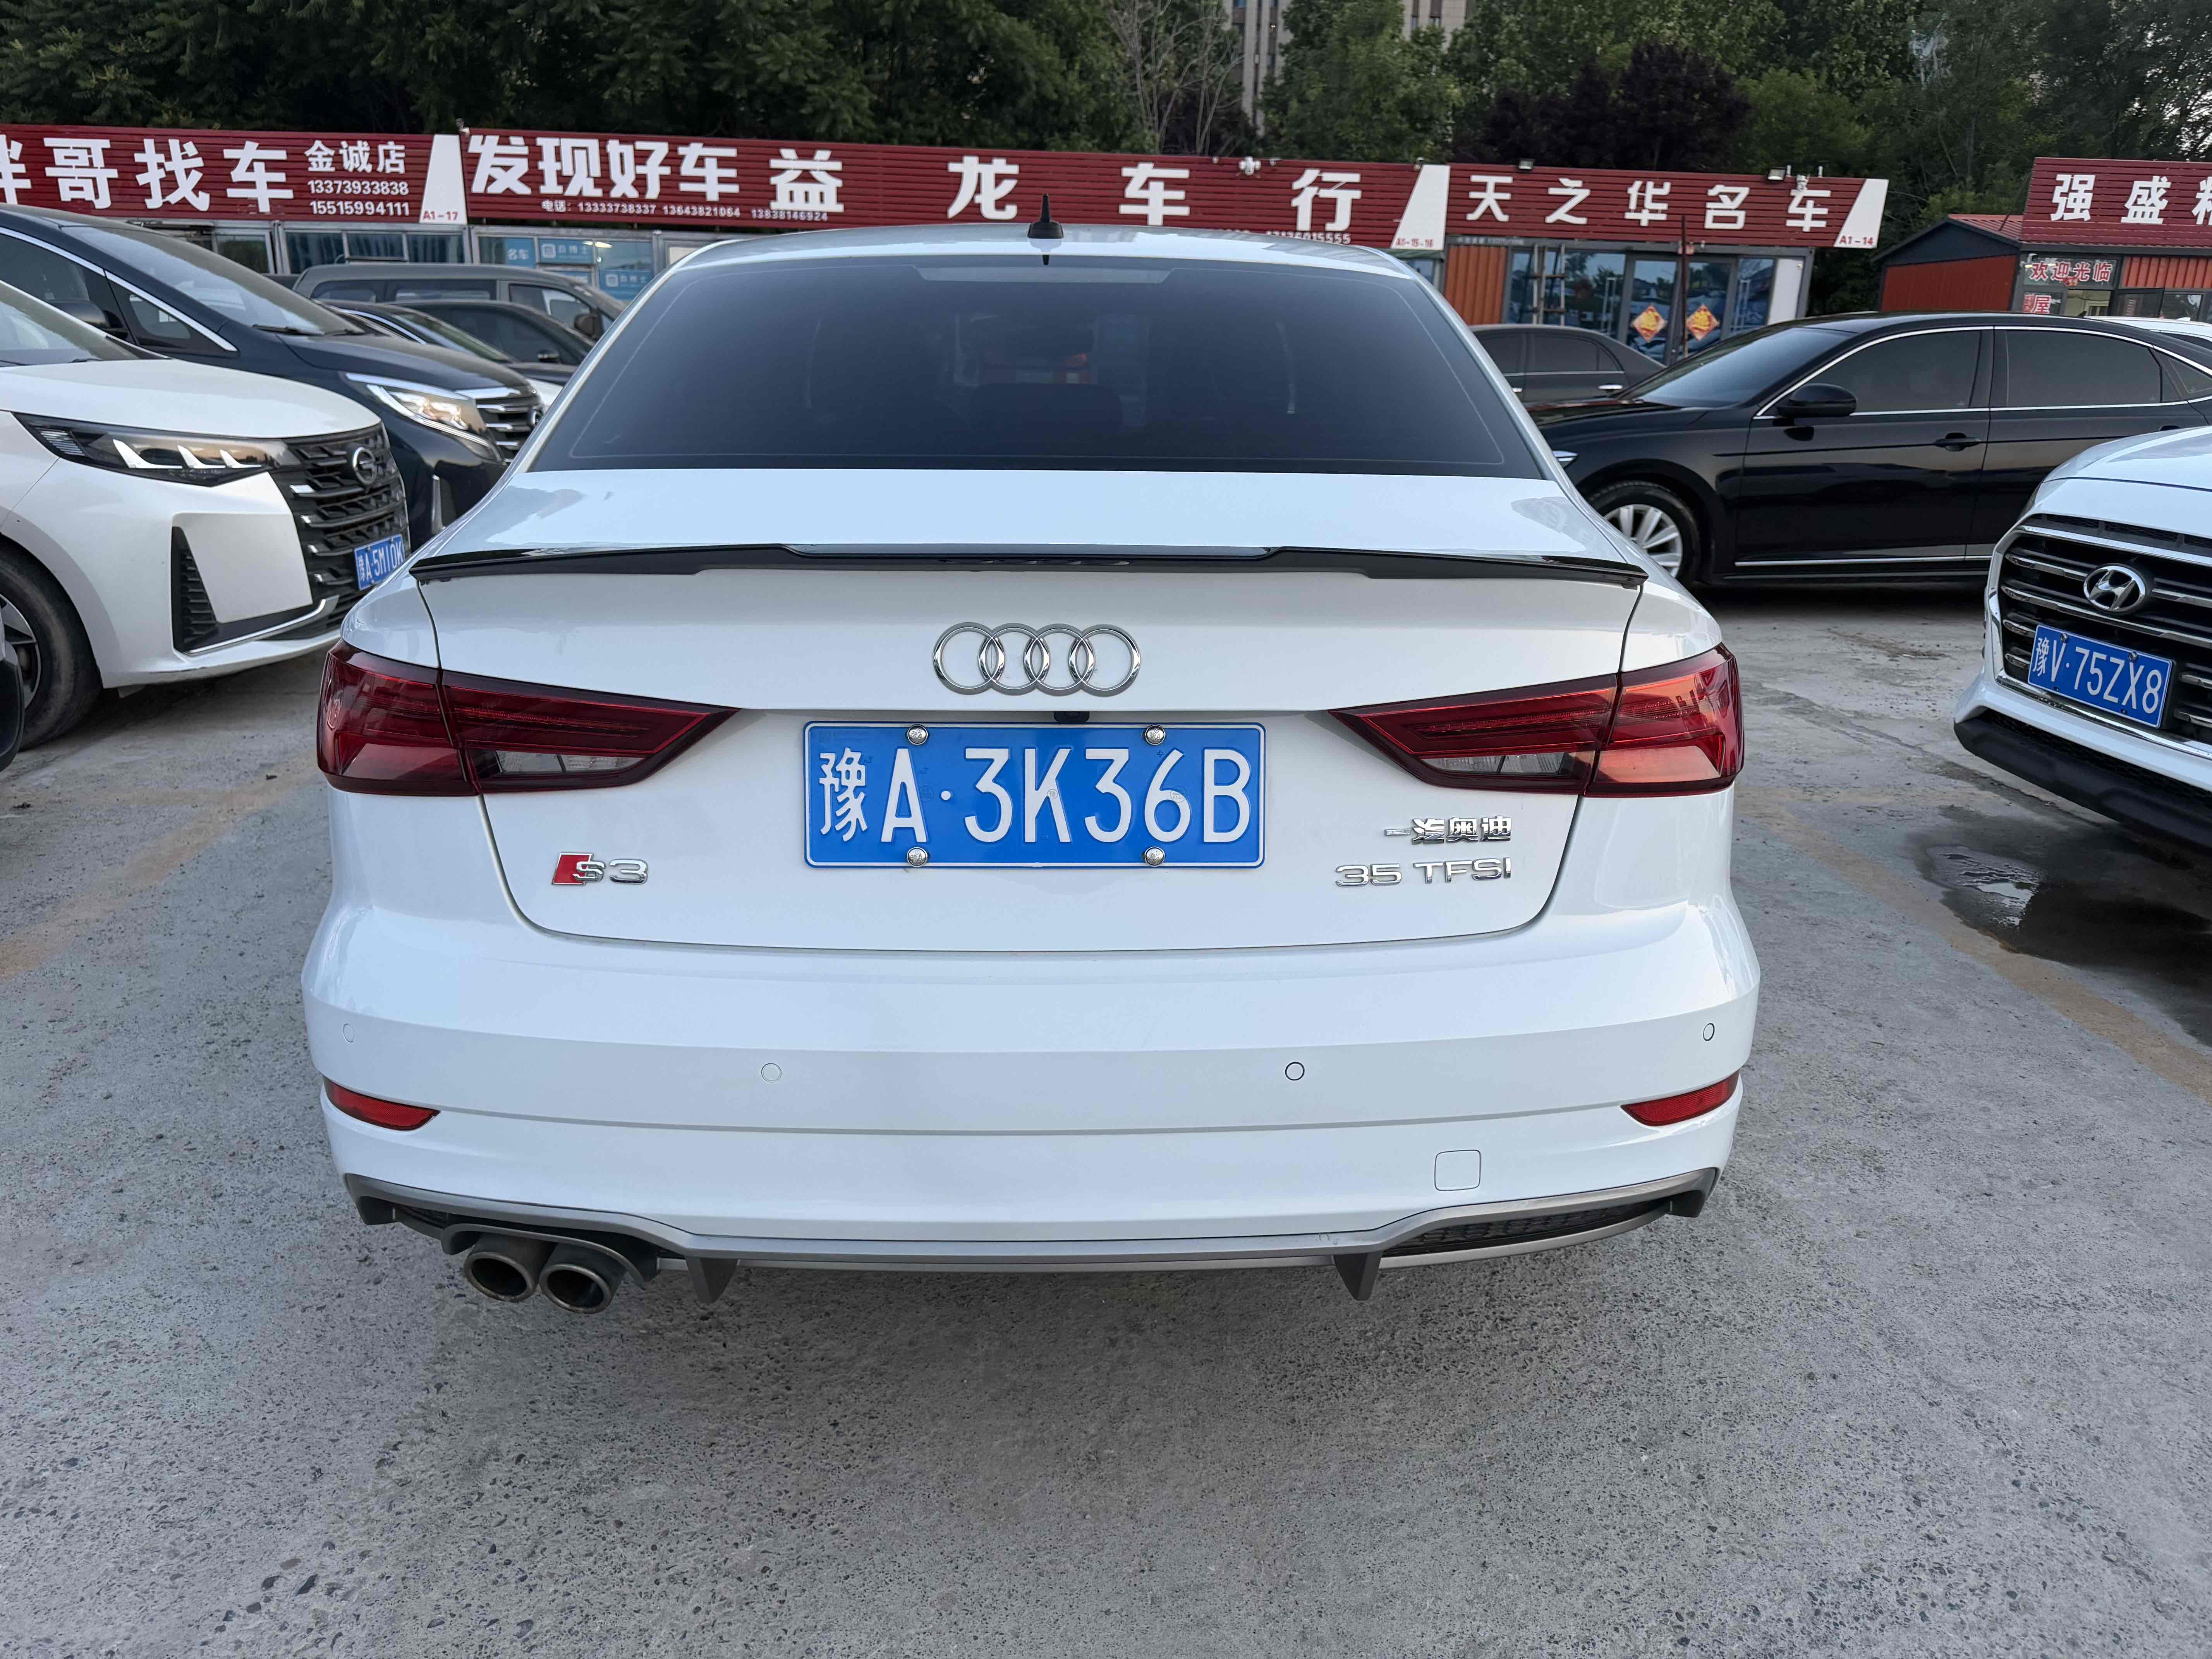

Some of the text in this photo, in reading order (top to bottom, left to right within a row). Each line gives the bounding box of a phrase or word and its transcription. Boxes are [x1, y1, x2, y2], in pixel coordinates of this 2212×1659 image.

[305, 140, 405, 174] 金诚店
[468, 135, 740, 202] 发现好车
[307, 179, 409, 196] 13373933838
[769, 148, 1362, 232] 益龙车行
[1466, 174, 1831, 232] 天之华名车
[309, 200, 410, 216] 15515994111
[2029, 261, 2113, 282] 欢迎光临
[819, 747, 1251, 842] 豫A·3K36B
[1384, 816, 1511, 845] 一汽奥迪
[572, 858, 648, 884] S3
[1335, 857, 1511, 888] 35 TFSI
